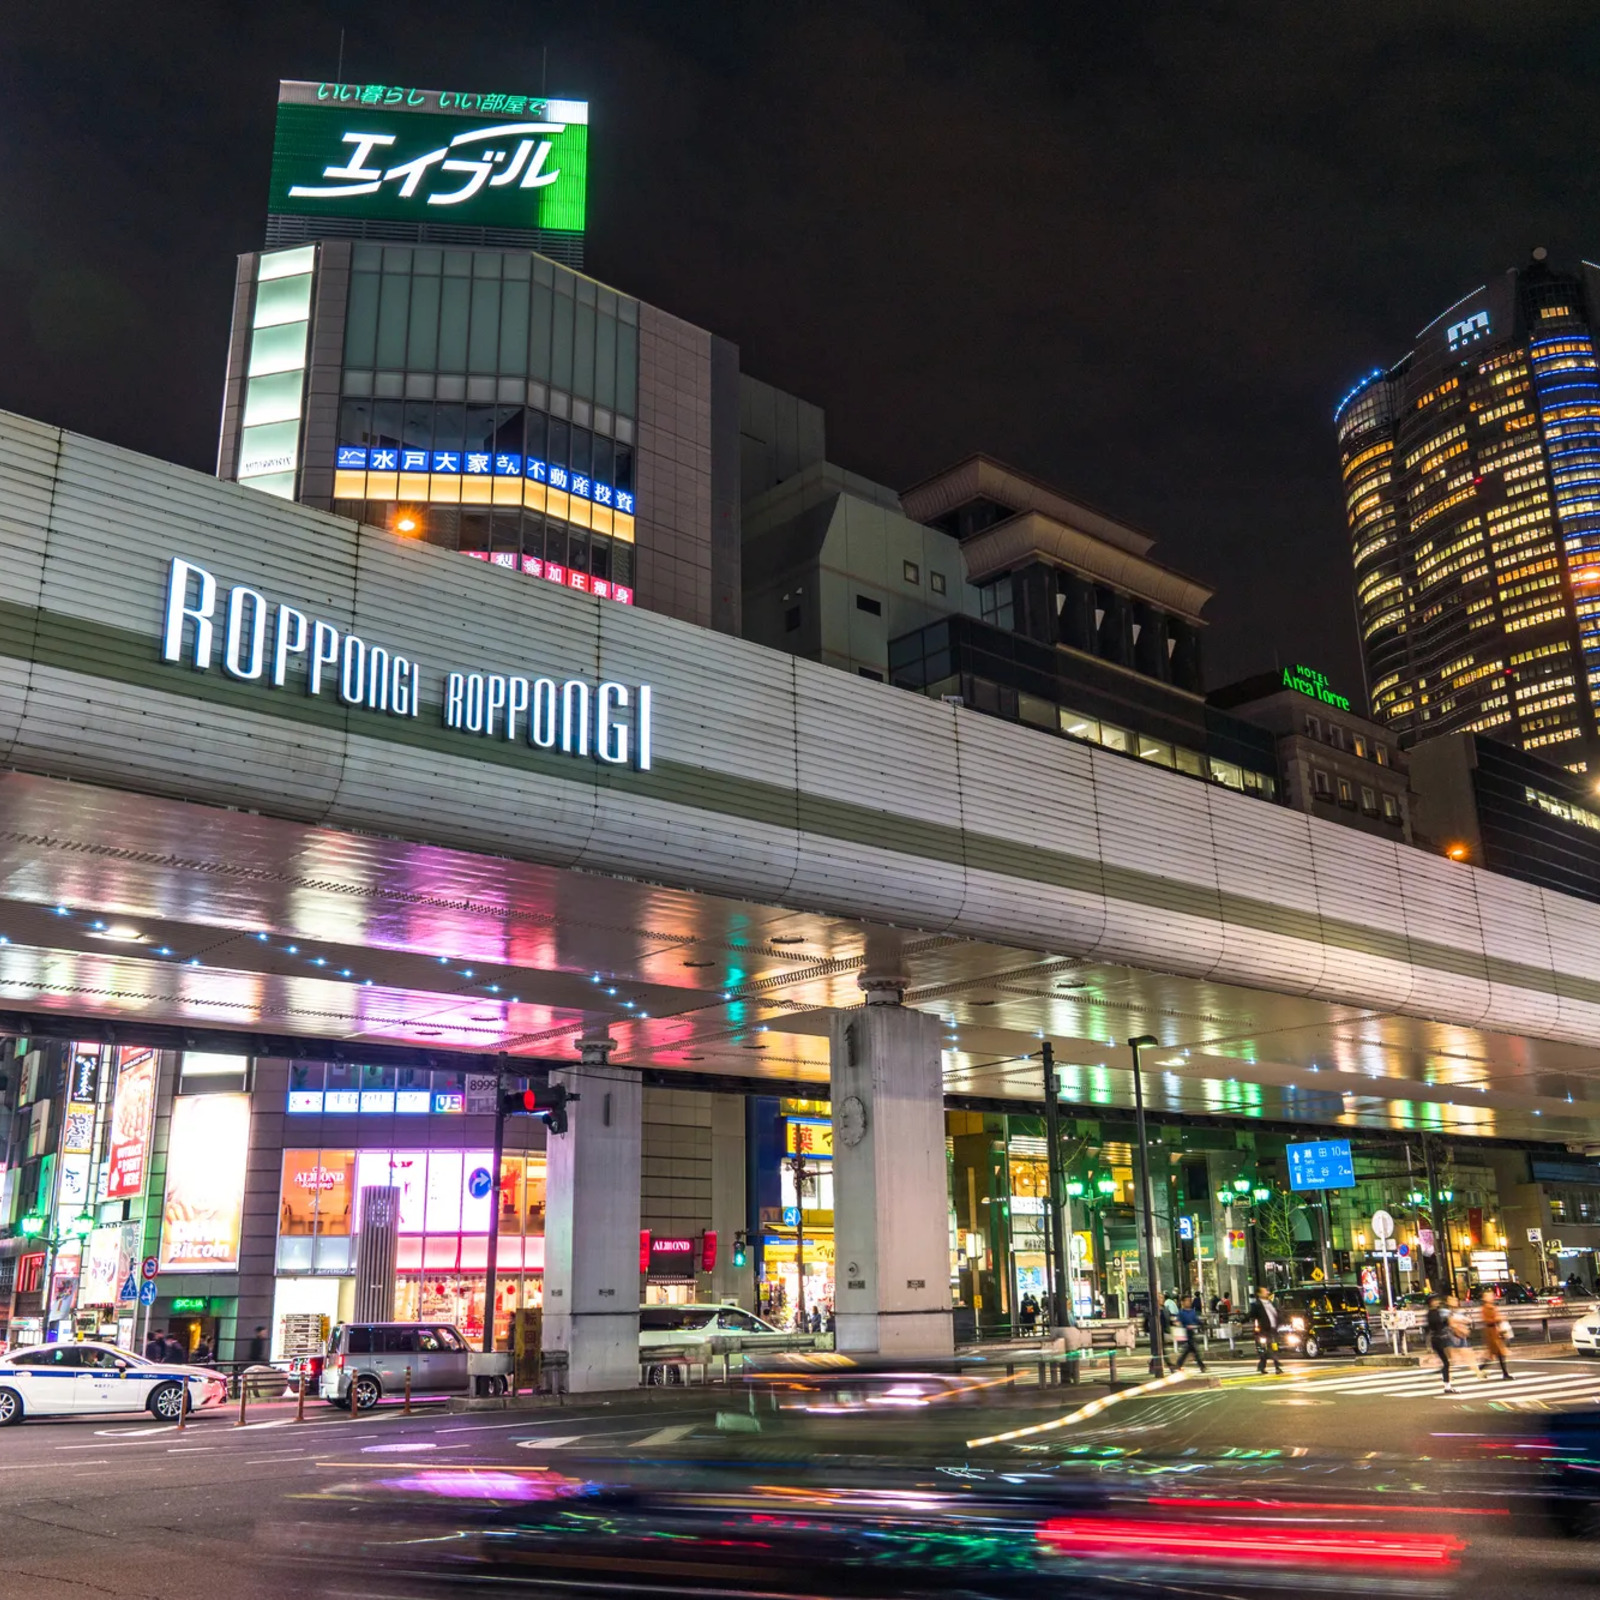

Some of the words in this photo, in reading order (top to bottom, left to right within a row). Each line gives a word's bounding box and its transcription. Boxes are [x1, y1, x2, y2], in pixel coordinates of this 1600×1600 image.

[317, 83, 426, 107] いい暮らし
[438, 90, 549, 116] いい部屋で
[288, 122, 566, 205] エイブル
[162, 557, 419, 717] ROPPONGI
[445, 673, 651, 771] ROPPONGI
[1296, 664, 1329, 686] HOTEL
[66, 1113, 87, 1148] やぶ屋
[170, 1243, 230, 1258] Bitcoin
[653, 1241, 690, 1251] ALMOND
